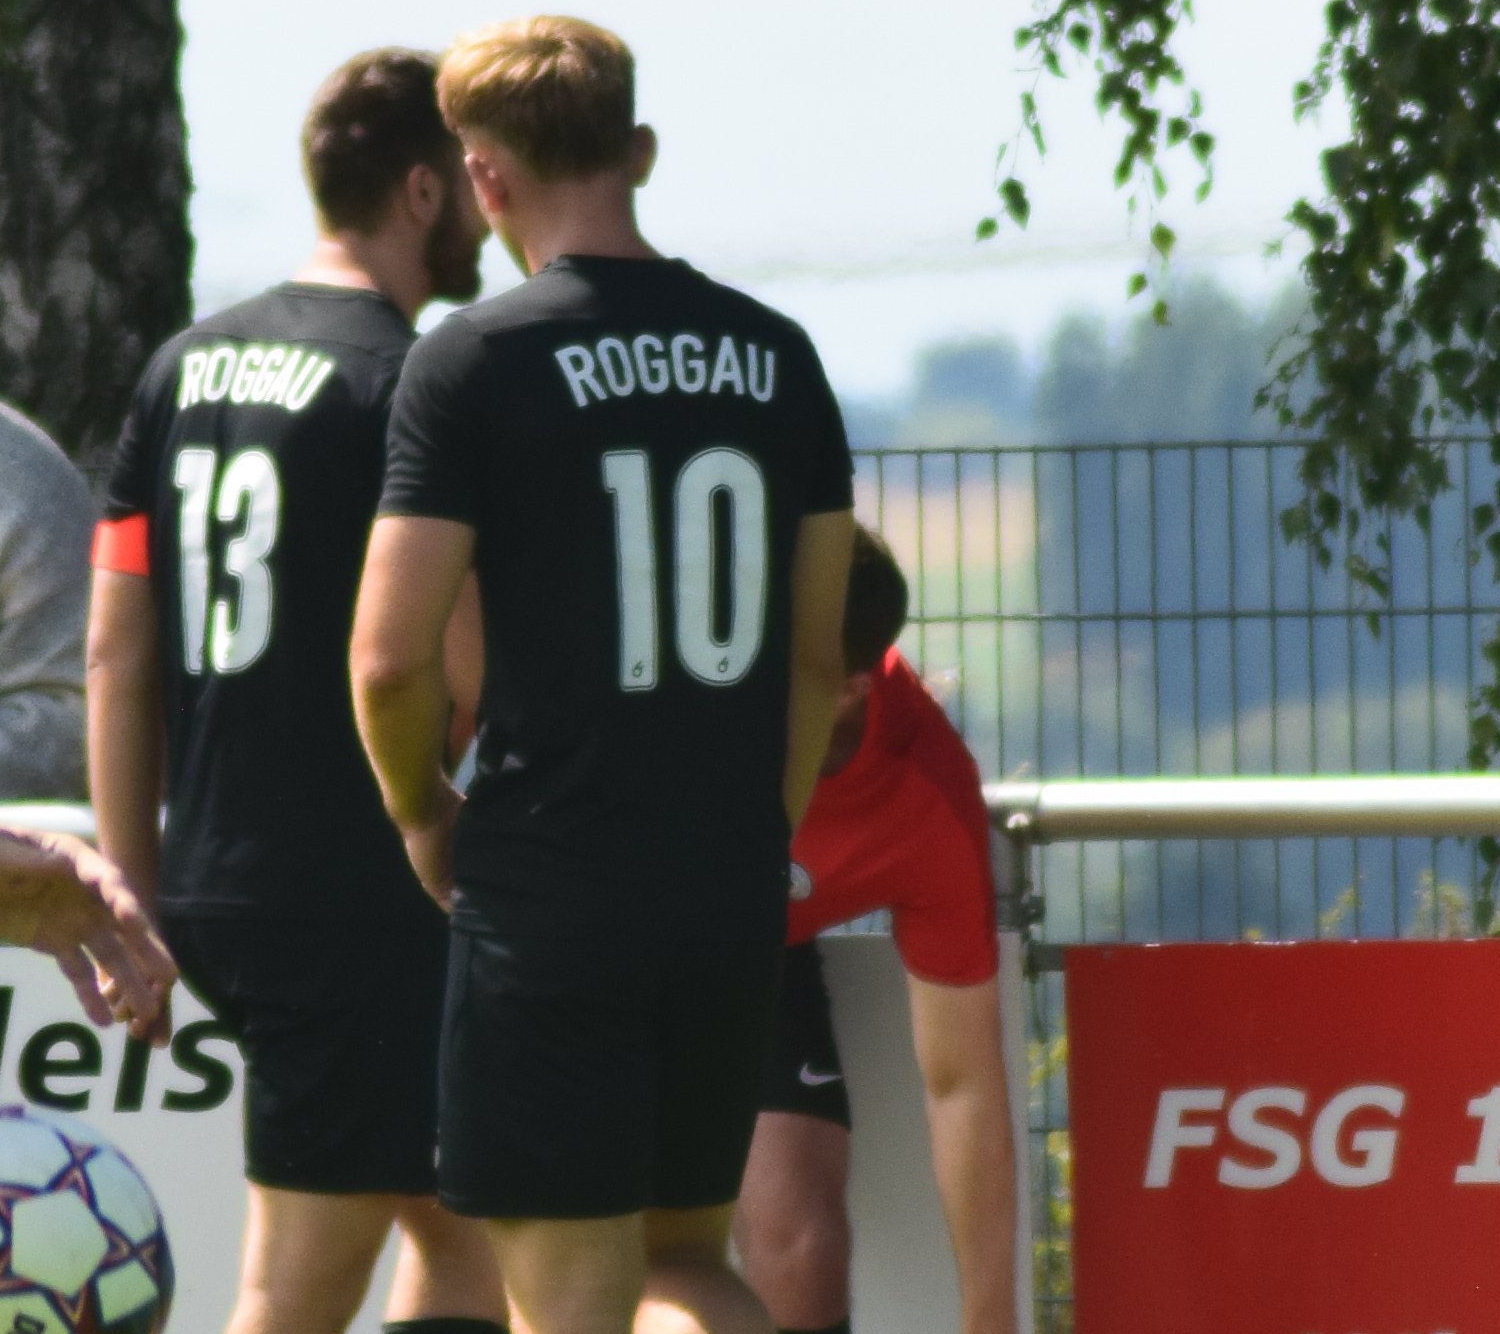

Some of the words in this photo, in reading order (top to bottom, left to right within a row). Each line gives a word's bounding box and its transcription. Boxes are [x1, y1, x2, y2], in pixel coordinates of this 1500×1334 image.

[177, 343, 334, 412] ROGGAU
[554, 334, 776, 408] ROGGAU
[174, 447, 281, 676] 13
[601, 447, 770, 692] 10
[1143, 1084, 1406, 1190] FSG
